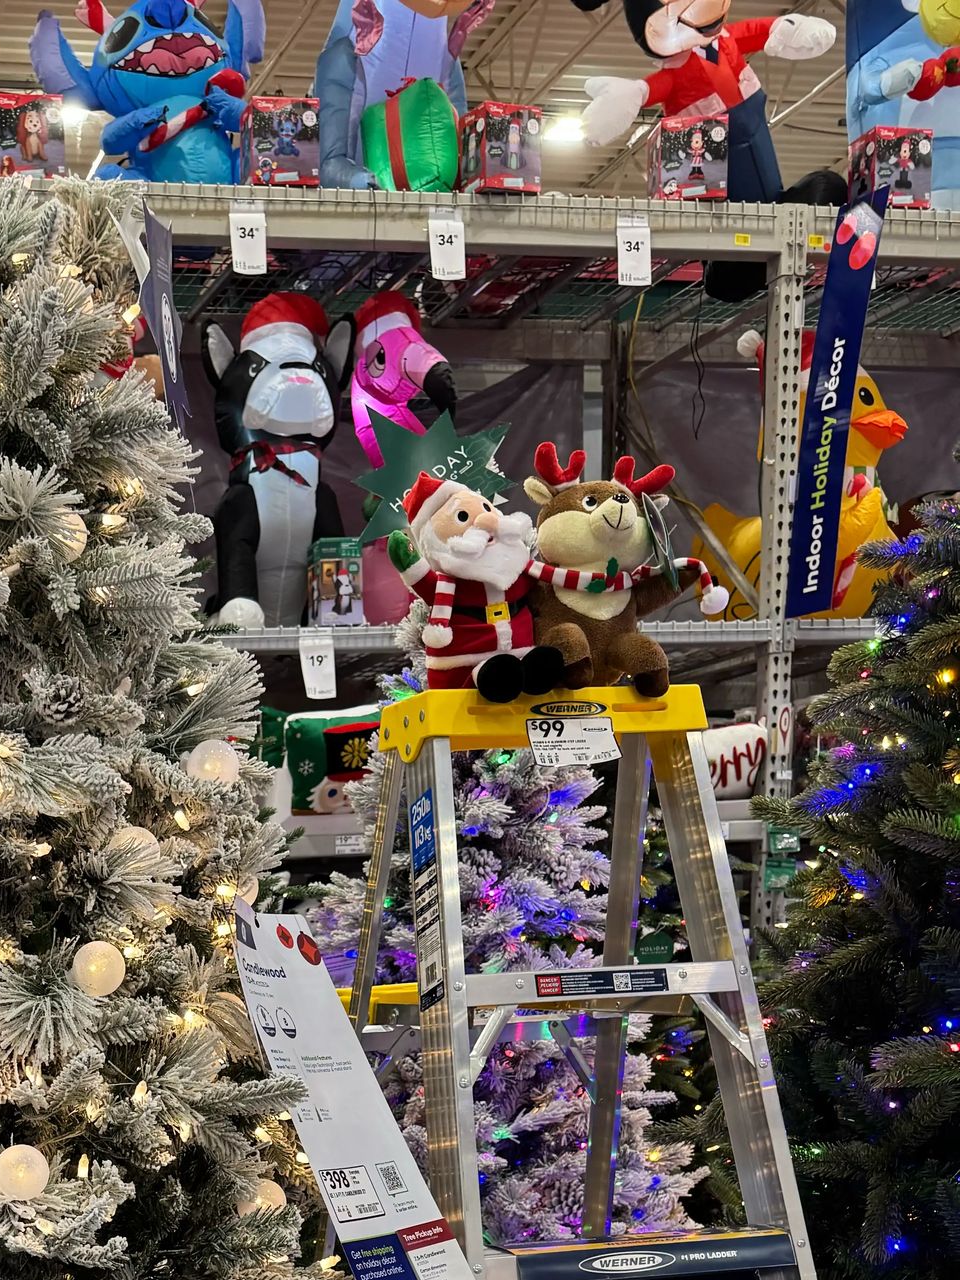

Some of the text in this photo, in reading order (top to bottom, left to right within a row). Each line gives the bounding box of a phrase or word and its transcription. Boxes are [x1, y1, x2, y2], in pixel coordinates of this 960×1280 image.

[256, 100, 274, 108] Disney
[488, 104, 504, 114] Disney
[880, 129, 894, 137] Disney
[803, 337, 847, 594] Indoor Holiday Décor
[546, 705, 592, 713] WERNER
[531, 720, 564, 738] $99
[710, 737, 766, 788] erry
[242, 958, 286, 978] Candlewood
[321, 1170, 350, 1190] $398
[402, 1226, 443, 1242] Tree Pickup Info
[351, 1244, 394, 1260] Get free shipping
[424, 1248, 446, 1258] Candlewood
[689, 1252, 705, 1260] PRO
[364, 1260, 382, 1268] holiday
[382, 1256, 396, 1266] décor
[600, 1255, 656, 1268] WERNER
